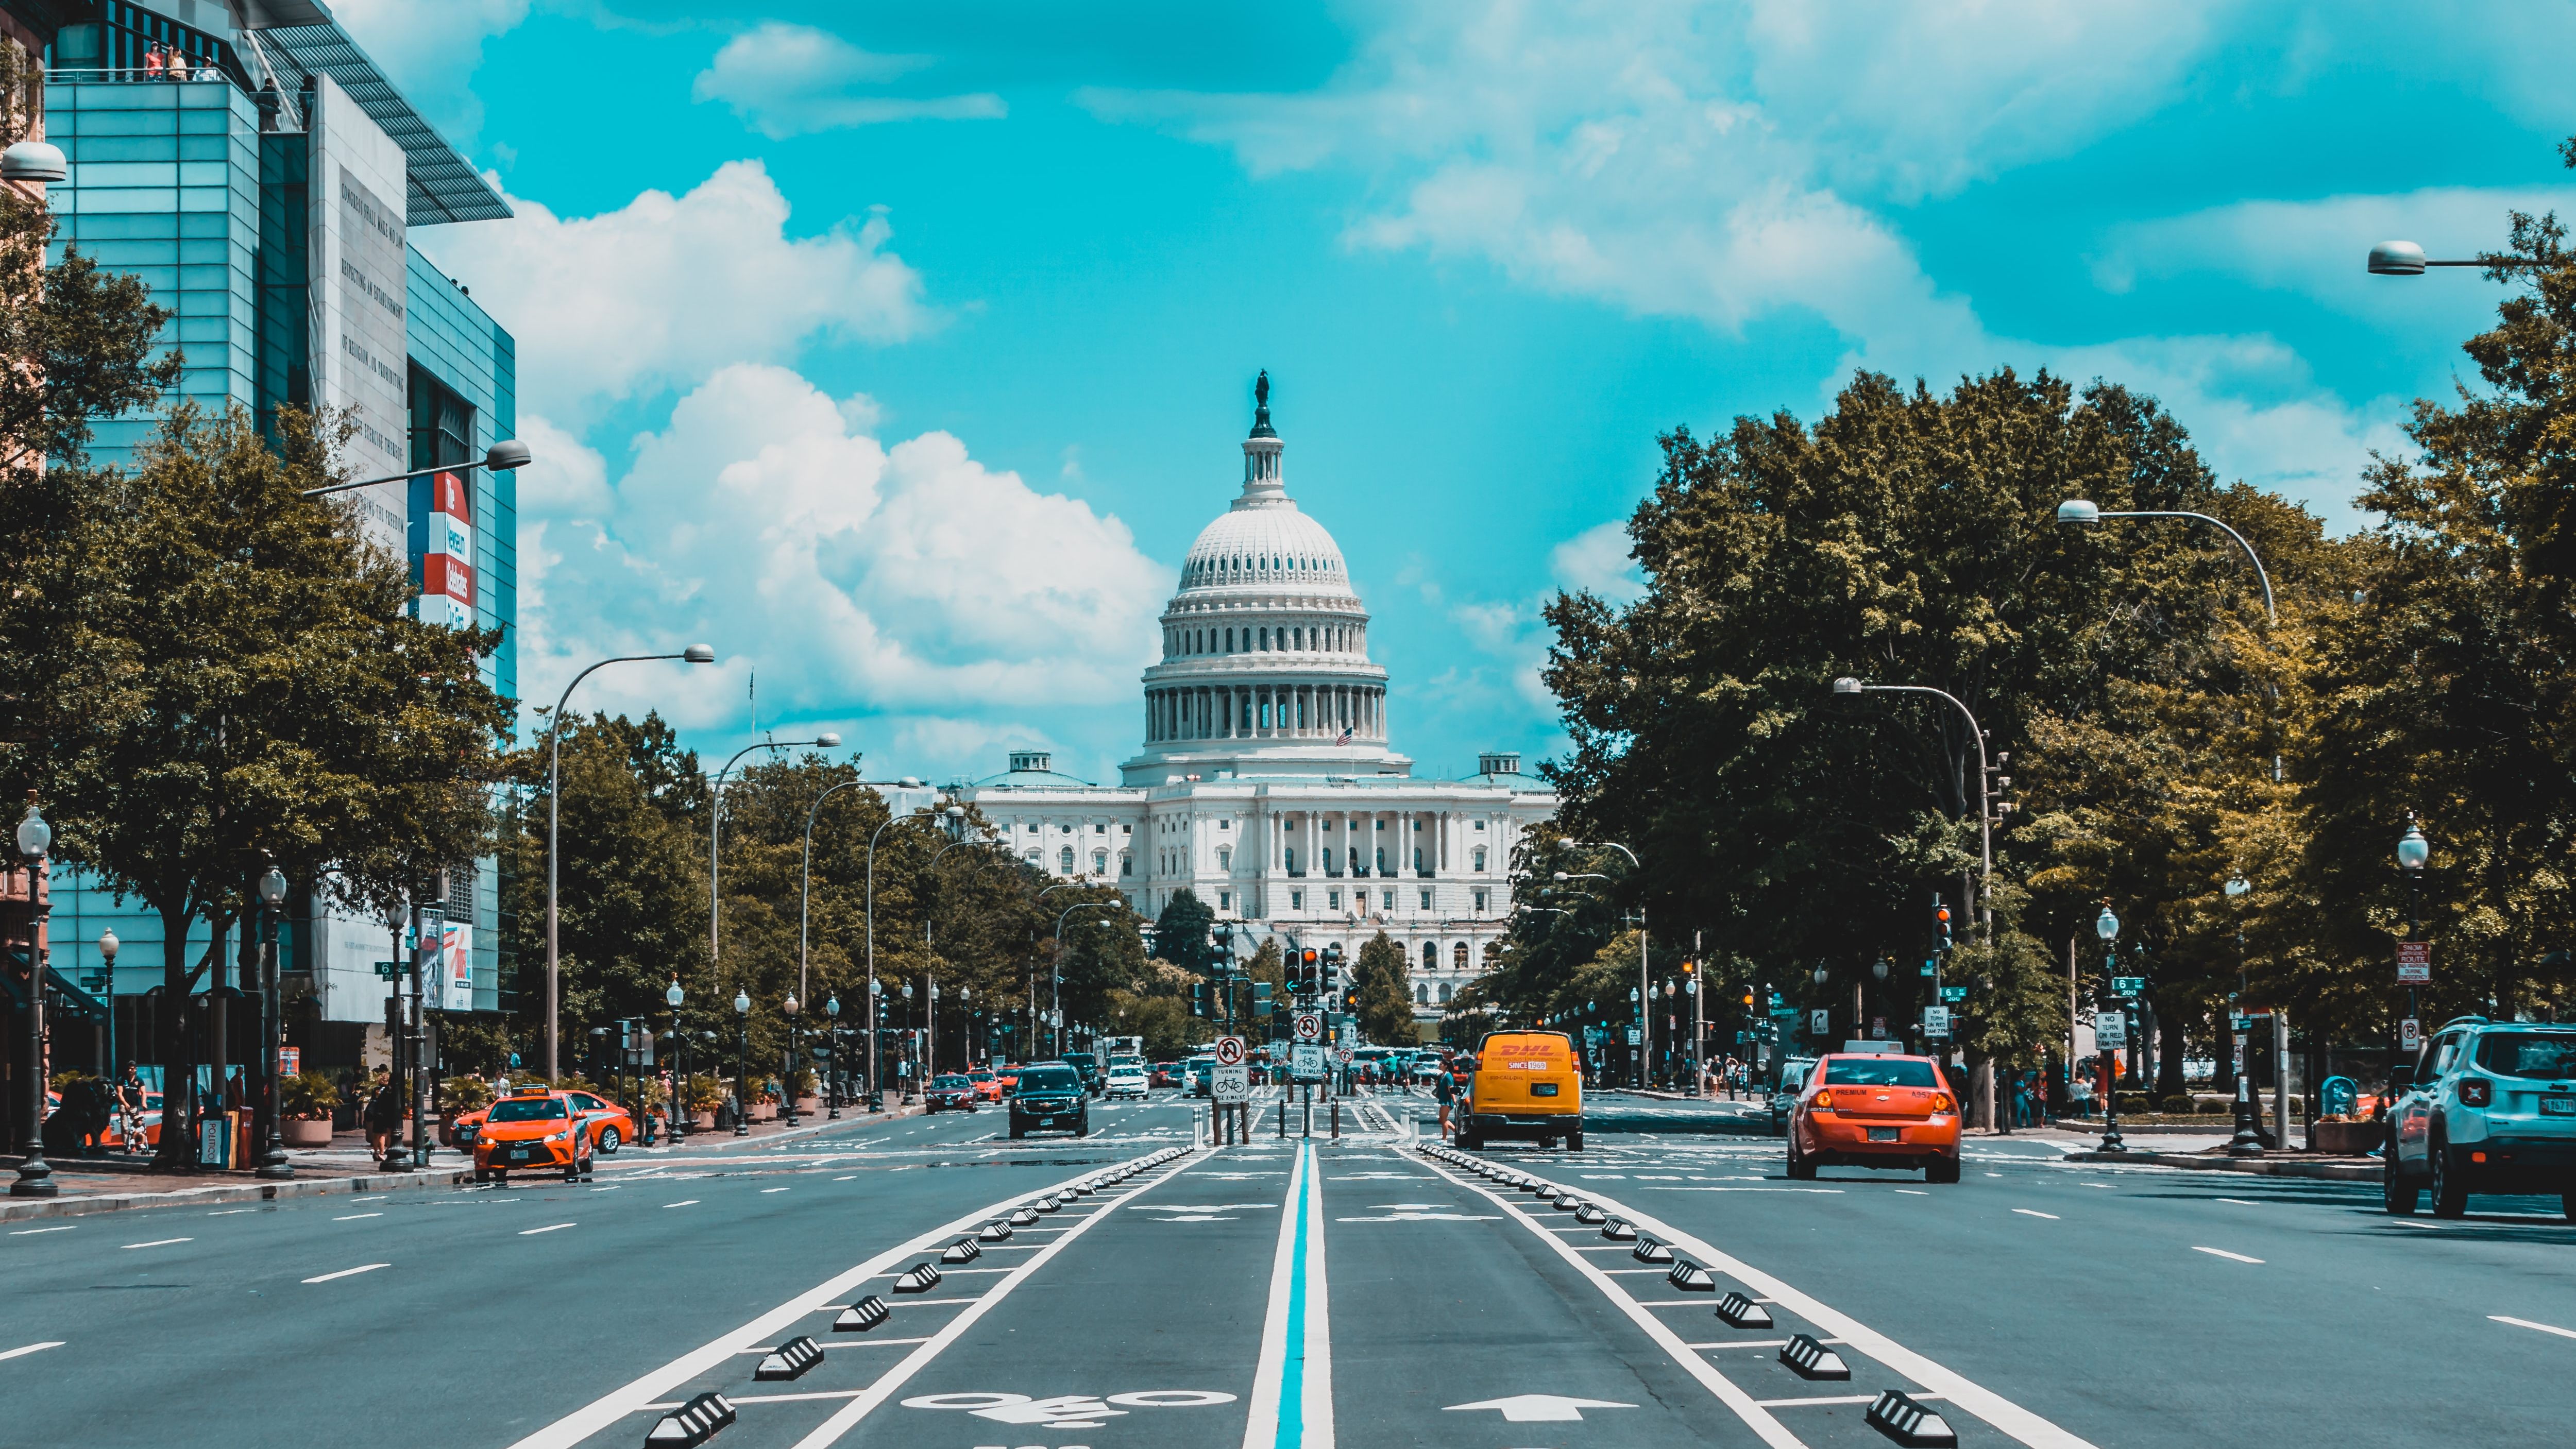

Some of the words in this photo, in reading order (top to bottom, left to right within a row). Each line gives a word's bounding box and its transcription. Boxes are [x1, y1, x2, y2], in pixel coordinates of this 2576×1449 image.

[341, 183, 363, 216] CONGRESS
[364, 203, 376, 228] SHALL
[378, 214, 388, 238] MAKE
[389, 226, 395, 244] NO
[342, 257, 366, 292] RESPECTING
[366, 279, 372, 297] AN
[374, 284, 403, 322] ESTABLISHMENT
[342, 333, 347, 351] OF
[371, 355, 377, 373] OR
[378, 360, 404, 393] PROHIBITING
[364, 423, 383, 450] EXERCISE
[446, 478, 455, 510] The
[386, 509, 404, 534] FREEDOM
[447, 520, 465, 556] Newseum
[447, 560, 467, 599] Celebrates
[382, 963, 389, 973] 6
[2119, 980, 2126, 988] 6
[1500, 1045, 1554, 1056] DHL
[2549, 1083, 2568, 1092] Jeep
[208, 1123, 216, 1160] POLITICO
